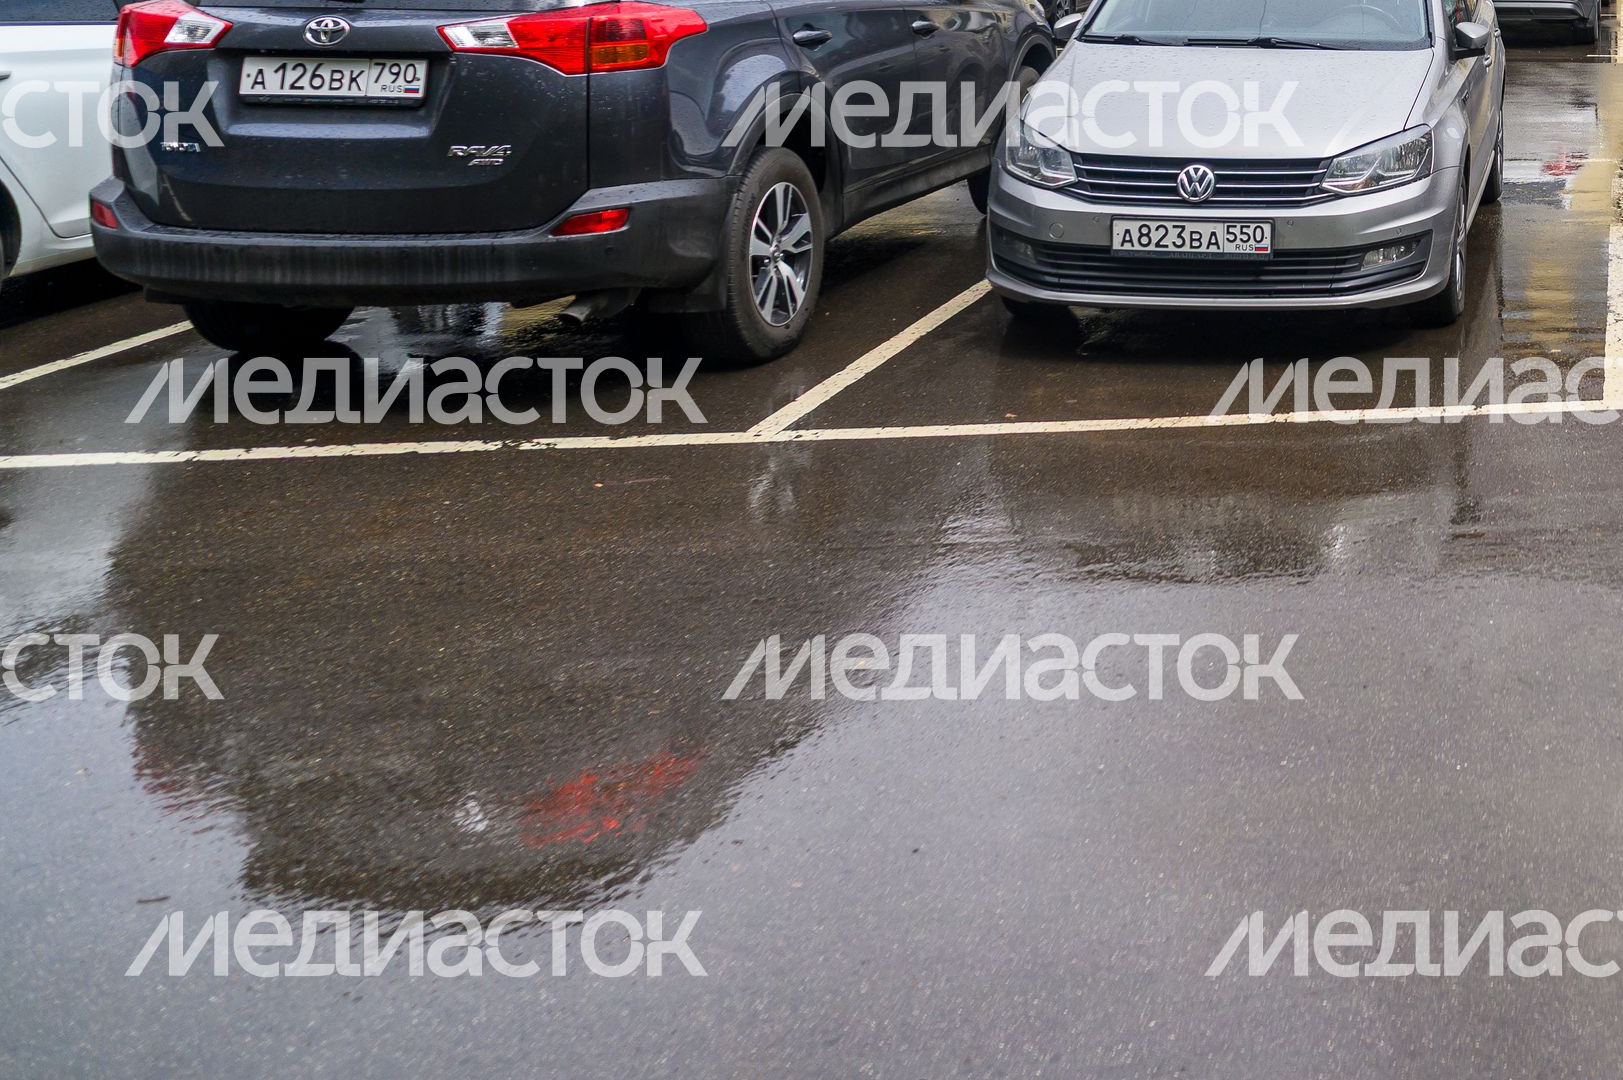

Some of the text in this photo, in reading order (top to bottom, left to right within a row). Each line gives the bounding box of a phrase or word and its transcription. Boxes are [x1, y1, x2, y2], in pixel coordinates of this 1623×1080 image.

[373, 62, 417, 84] 790
[380, 85, 403, 94] RUS
[448, 145, 511, 157] RAV4
[1225, 225, 1265, 244] 550
[1235, 244, 1254, 252] RUS
